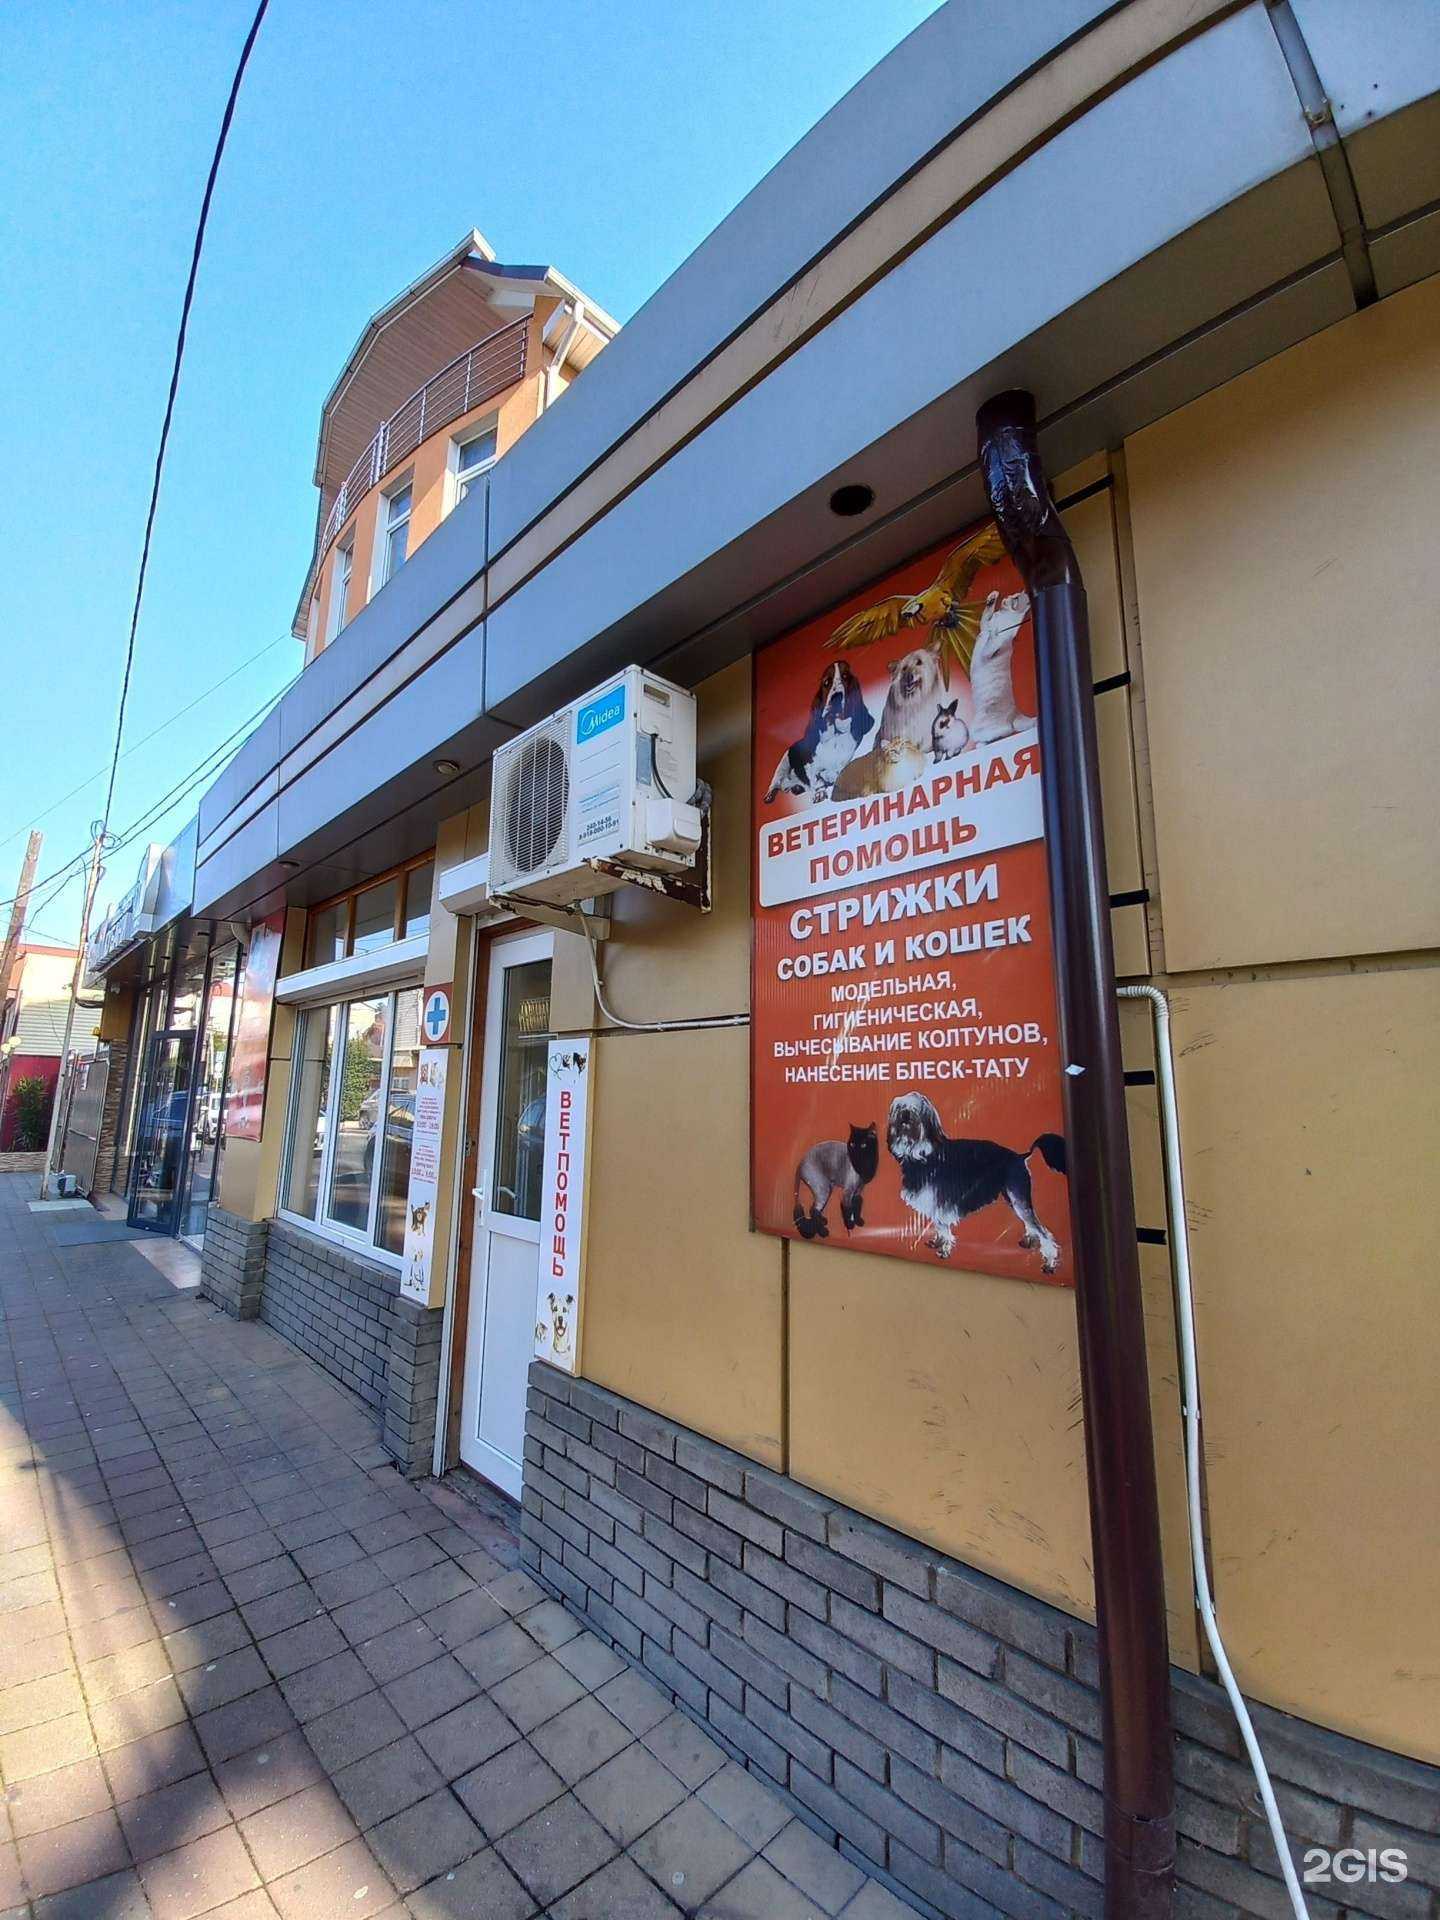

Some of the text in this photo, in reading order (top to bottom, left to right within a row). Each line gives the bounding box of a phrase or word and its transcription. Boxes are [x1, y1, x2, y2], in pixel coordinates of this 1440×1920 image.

[581, 705, 621, 735] Midea
[767, 743, 1042, 858] ВЕТЕРИНАРНАЯ
[809, 815, 977, 884] ПОМОЩЬ
[789, 863, 999, 940] СТРИЖКИ
[777, 914, 1033, 981] СОБАК И КОШЕК
[831, 970, 957, 1003] МОДЕЛЬНАЯ,
[773, 1022, 1048, 1058] ВЫЧЕСЫВАНИЕ КОЛТУНОВ,
[813, 998, 983, 1031] ГИГИЕНИЧЕСКАЯ,
[784, 1056, 1030, 1083] НАНЕСЕНИЕ БЛЕСК-ТАТУ
[552, 1091, 571, 1277] ВЕТПОМОЩЬ
